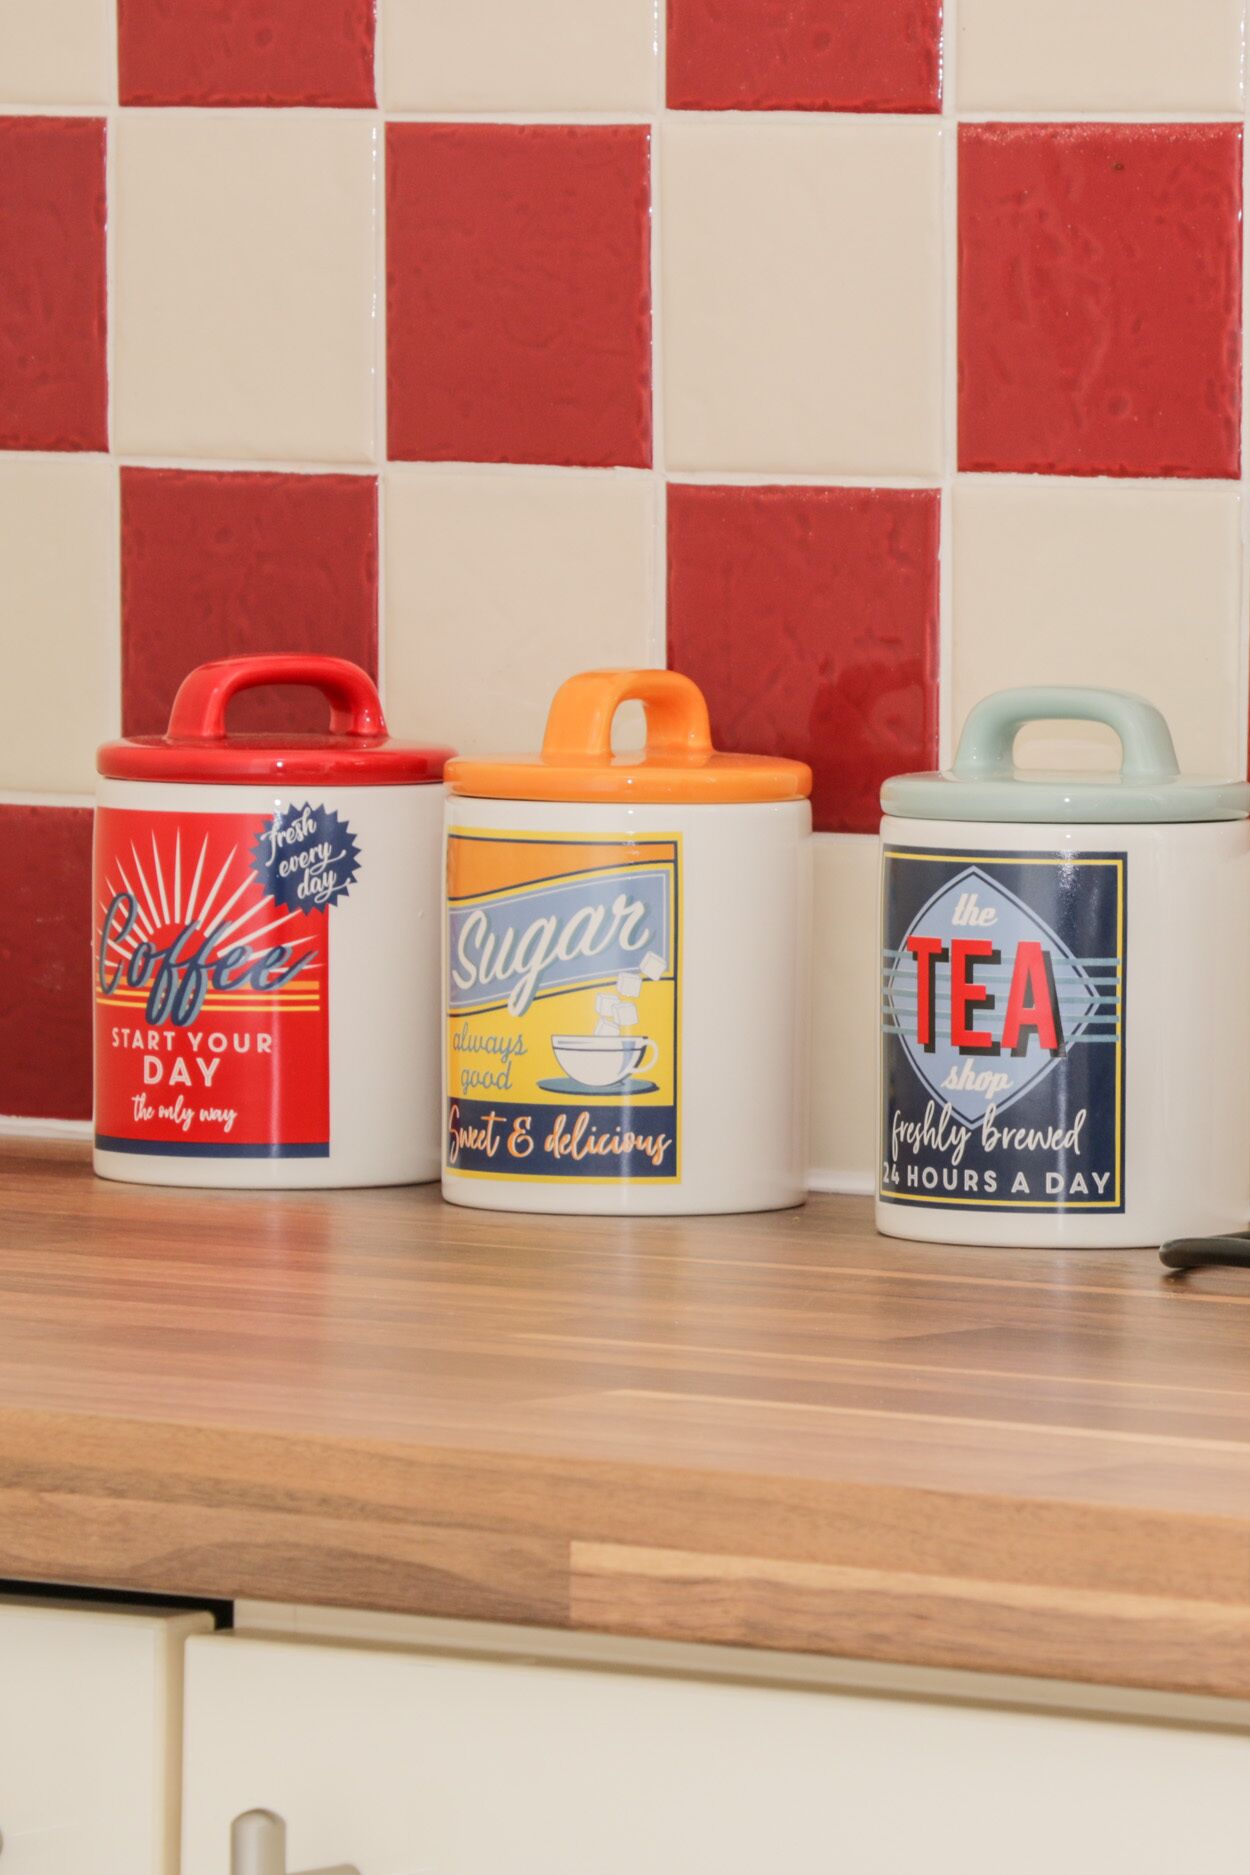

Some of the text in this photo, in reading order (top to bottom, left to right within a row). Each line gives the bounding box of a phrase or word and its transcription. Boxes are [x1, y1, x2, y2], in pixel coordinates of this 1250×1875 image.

[261, 806, 316, 866] fresh
[278, 842, 346, 878] every
[296, 869, 352, 903] day
[952, 893, 998, 926] the
[100, 892, 319, 1026] Coffee
[452, 894, 652, 1017] Sugar
[907, 935, 1064, 1055] TEA
[112, 1027, 272, 1053] START YOUR
[453, 1022, 528, 1063] always
[143, 1055, 221, 1087] DAY
[460, 1061, 513, 1094] good
[940, 1058, 1013, 1099] shop
[132, 1092, 238, 1133] the only way
[892, 1100, 1087, 1166] freshly brewed
[449, 1104, 506, 1164] Sweet
[544, 1111, 673, 1166] delicious
[882, 1162, 1111, 1195] 24 HOURS A DAY
